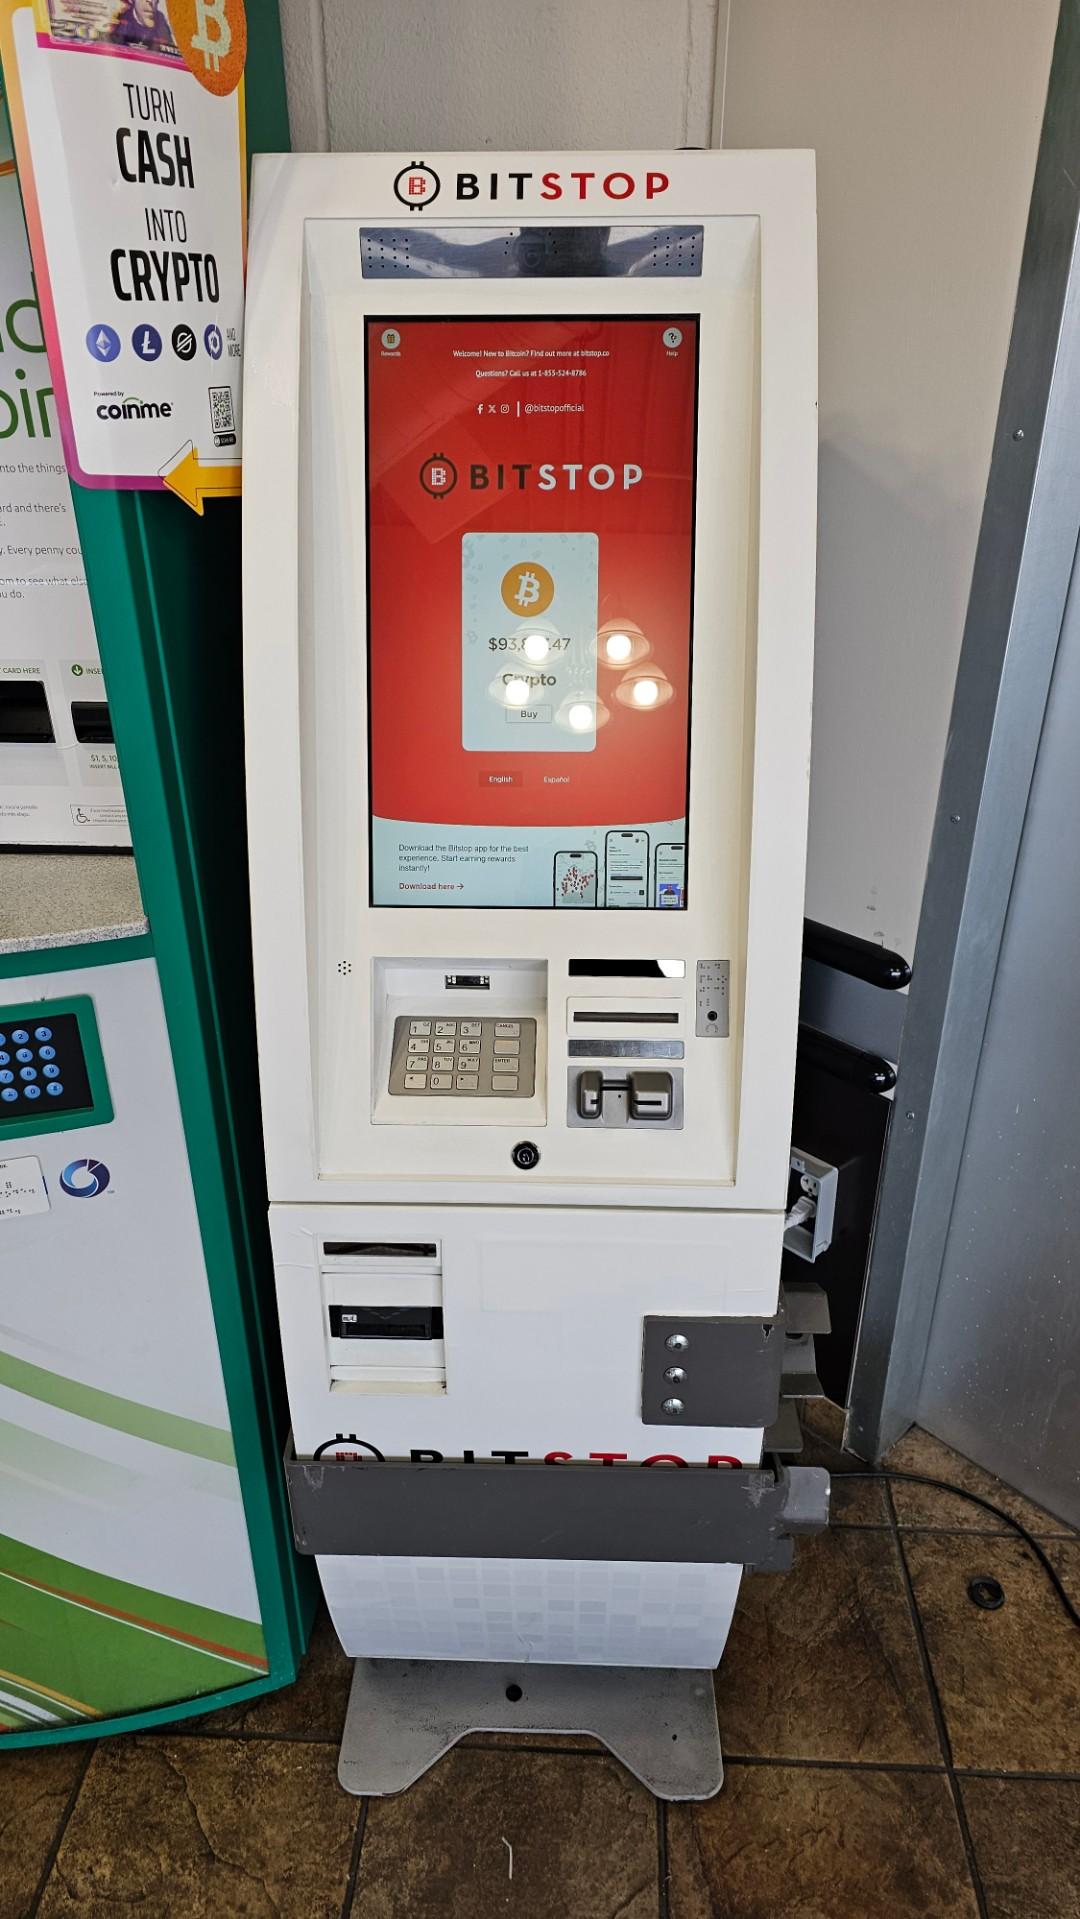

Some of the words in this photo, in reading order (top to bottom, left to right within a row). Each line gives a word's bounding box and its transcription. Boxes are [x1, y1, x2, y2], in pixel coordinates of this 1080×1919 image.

[123, 83, 177, 125] TURN
[116, 127, 195, 188] CASH
[456, 172, 669, 200] BITSTOP
[144, 207, 188, 243] INTO
[110, 249, 220, 303] CRYPTO
[452, 349, 482, 357] Welcome!
[483, 349, 497, 357] New
[505, 349, 530, 357] Bitcoin?
[580, 350, 610, 358] bitstop.co
[475, 369, 508, 378] Questions?
[509, 369, 521, 377] Call
[96, 400, 172, 420] coinme
[524, 403, 585, 414] @bitstopofficial
[17, 462, 35, 473] the
[36, 462, 66, 475] things
[469, 463, 643, 491] BITSTOP
[14, 502, 32, 513] and
[34, 502, 66, 513] there's
[7, 545, 33, 556] Every
[34, 546, 64, 556] penny
[15, 577, 27, 586] to
[28, 577, 44, 586] see
[9, 589, 25, 598] do.
[520, 710, 538, 720] Buy
[488, 775, 513, 784] English
[543, 775, 570, 784] Español
[398, 843, 434, 852] Download
[435, 844, 447, 852] the
[448, 844, 473, 853] Bitstop
[474, 845, 487, 854] app
[500, 845, 512, 853] the
[513, 845, 529, 853] best
[398, 854, 439, 863] experience.
[441, 854, 458, 862] Start
[459, 855, 486, 864] earning
[487, 854, 516, 862] rewards
[398, 864, 430, 873] instantly!
[399, 882, 437, 890] Download
[438, 882, 455, 890] here
